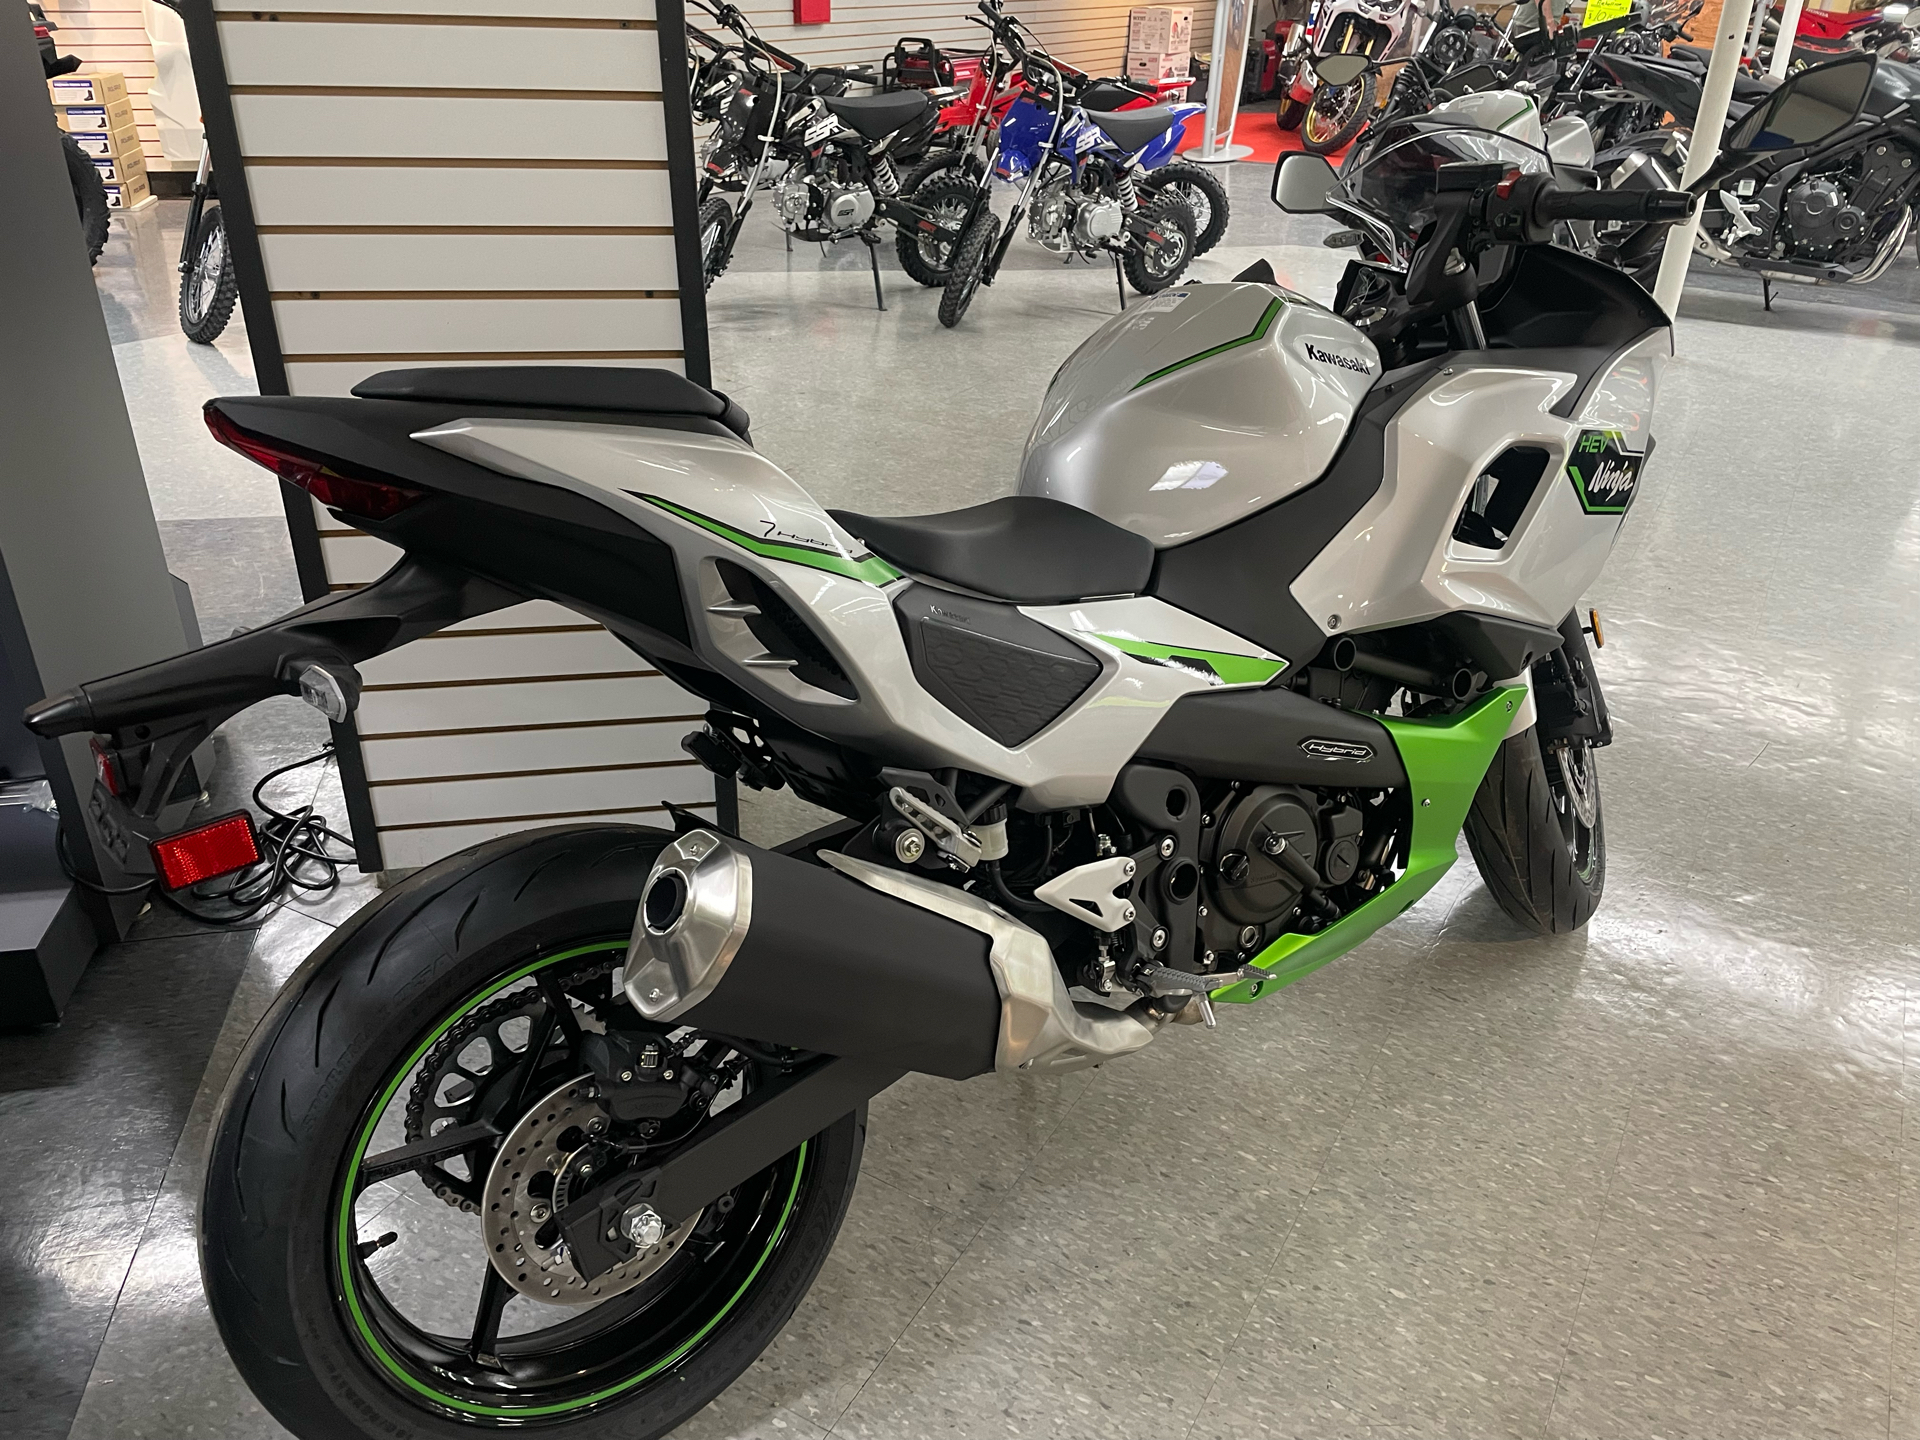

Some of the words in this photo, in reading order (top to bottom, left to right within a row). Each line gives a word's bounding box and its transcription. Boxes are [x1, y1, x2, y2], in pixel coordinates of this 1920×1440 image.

[1805, 7, 1829, 18] HONDA
[804, 113, 839, 147] SSR
[1075, 125, 1101, 154] SSR
[1304, 342, 1371, 376] Kawasaki
[1578, 434, 1609, 454] HEV
[1587, 459, 1634, 502] Ninja
[759, 519, 776, 538] 7
[1308, 743, 1367, 756] Hybrid
